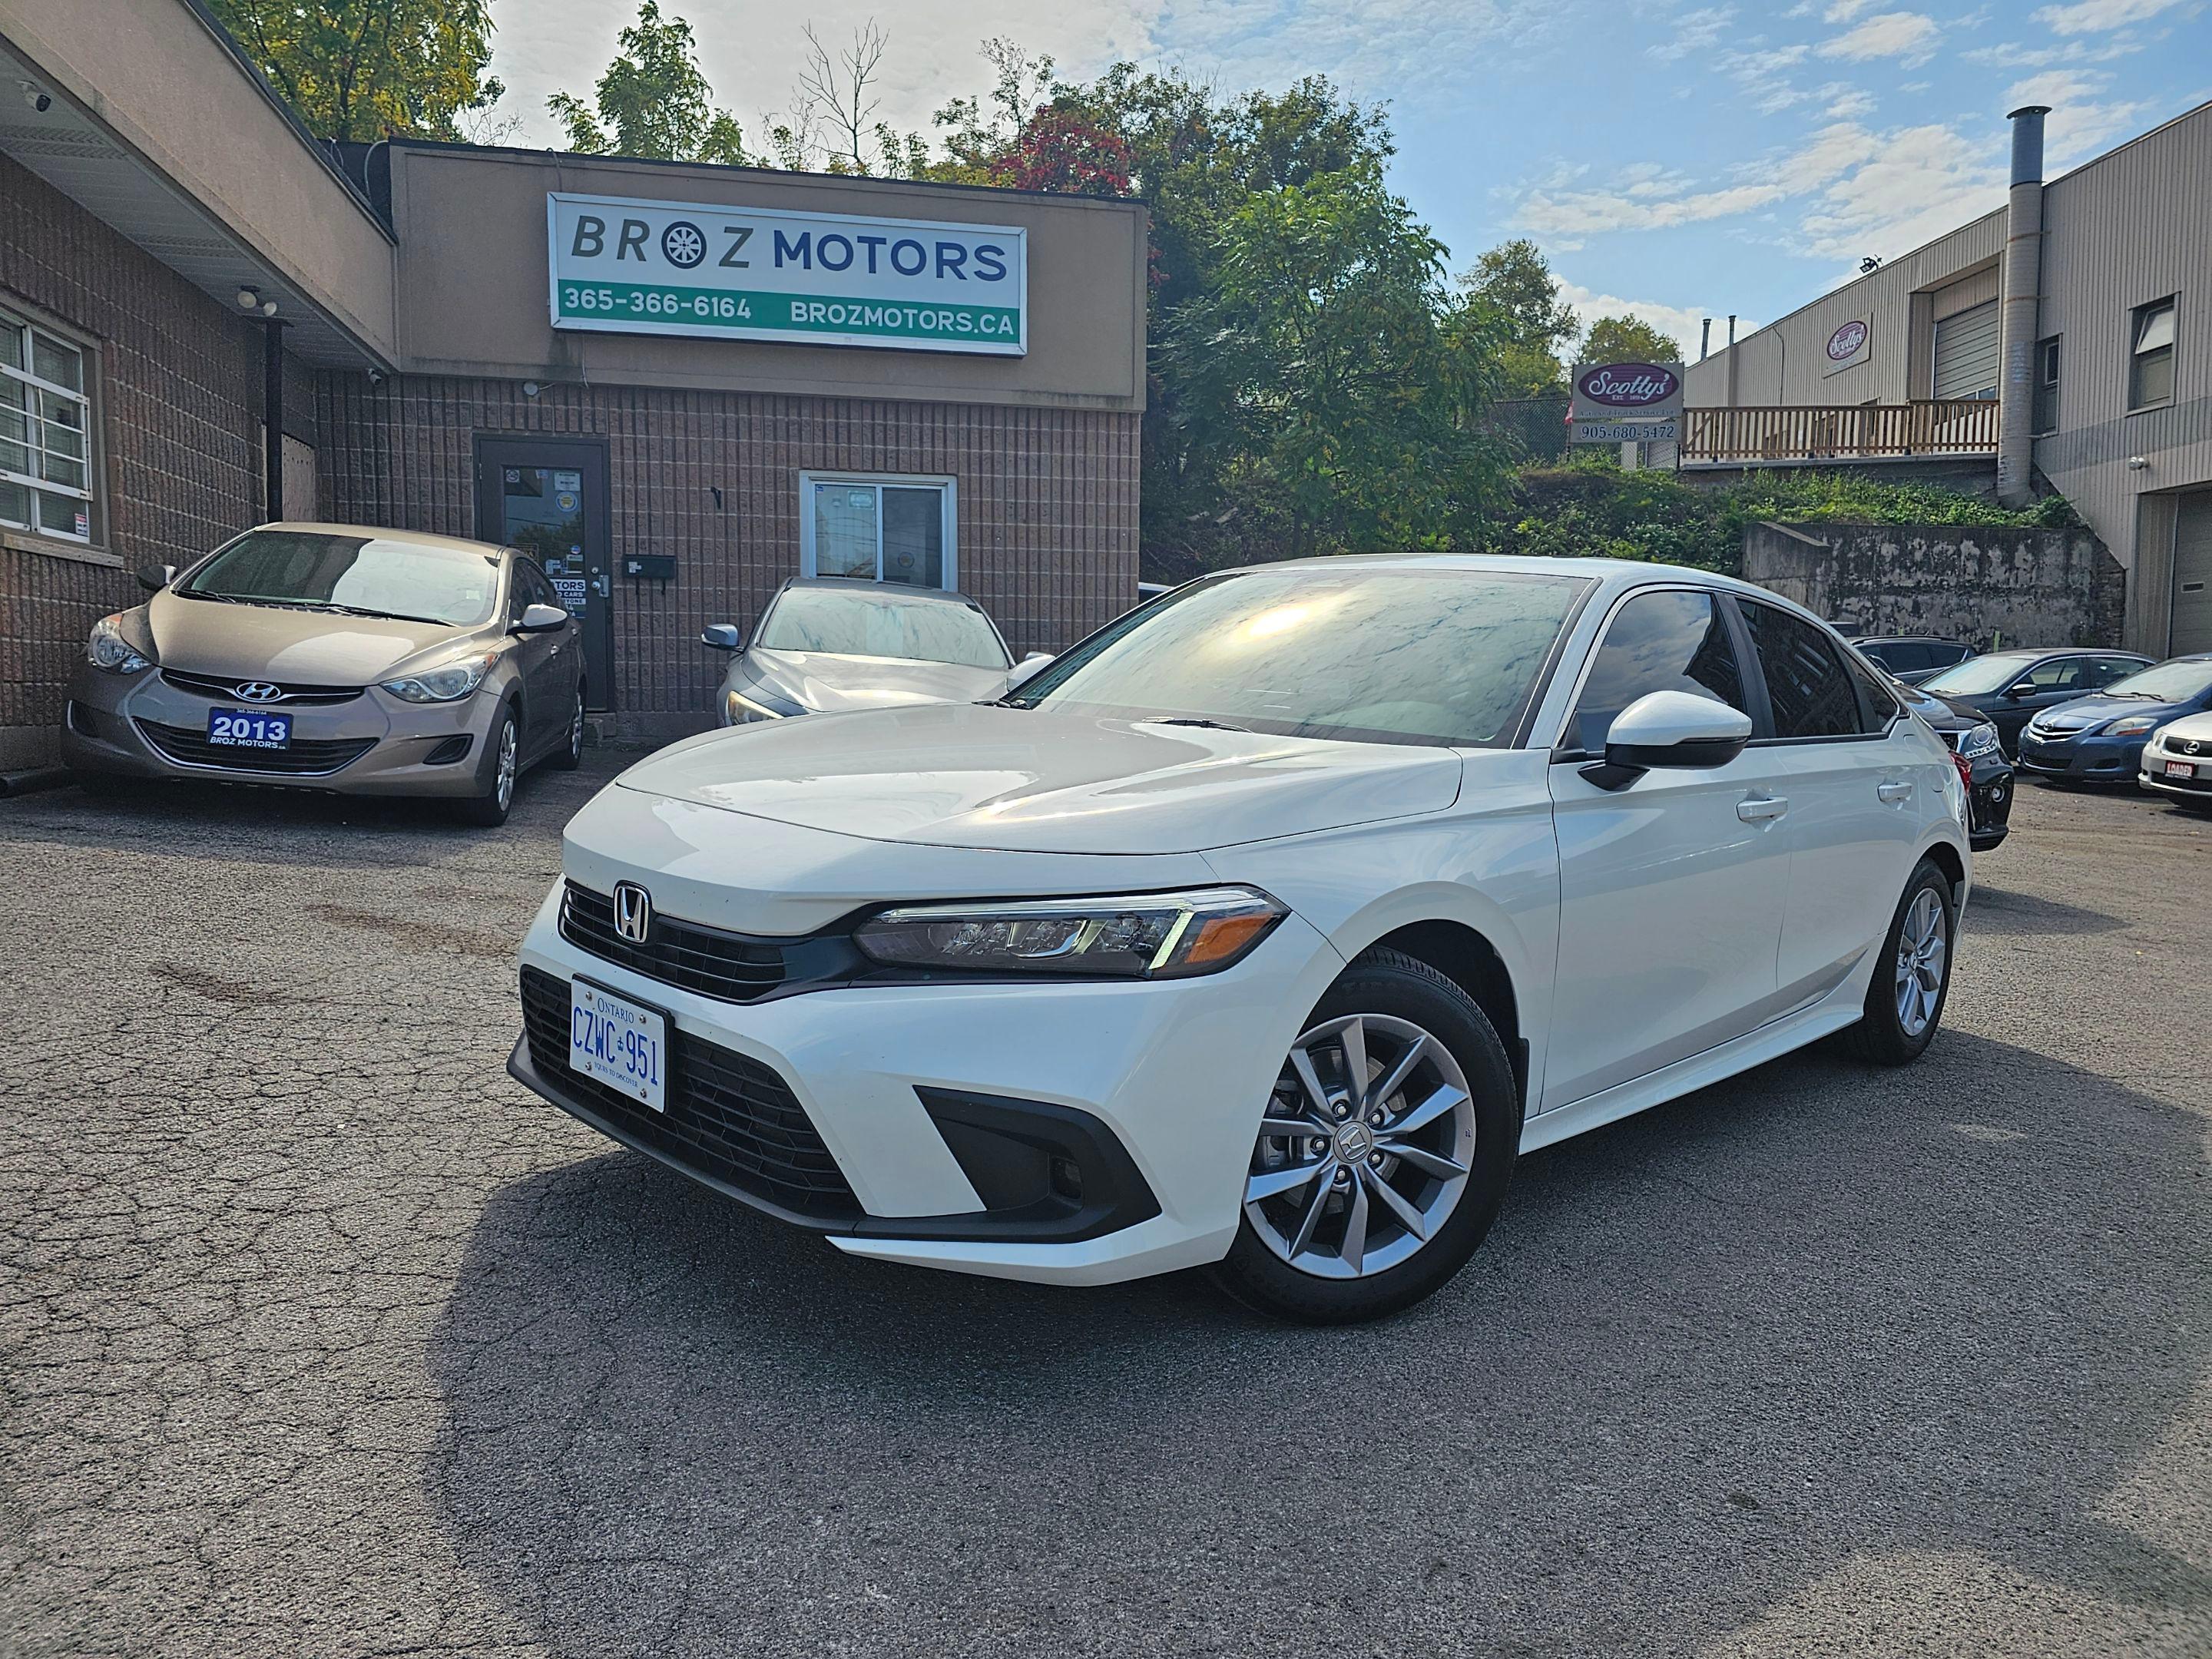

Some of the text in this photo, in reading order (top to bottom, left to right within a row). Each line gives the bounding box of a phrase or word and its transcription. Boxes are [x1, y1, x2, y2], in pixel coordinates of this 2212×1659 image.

[571, 215, 1007, 281] BROZ MOTORS
[565, 287, 1014, 335] 365-366-6164 BROZMOTORS.CA
[1588, 371, 1670, 400] Scotty's
[1581, 426, 1674, 439] 905-680-5472
[210, 737, 236, 745] BROZ
[213, 717, 286, 740] 2013
[598, 998, 634, 1024] ONTARIO
[626, 1030, 657, 1086] 951
[609, 1068, 615, 1077] TO
[615, 1072, 638, 1088] DISCOVER
